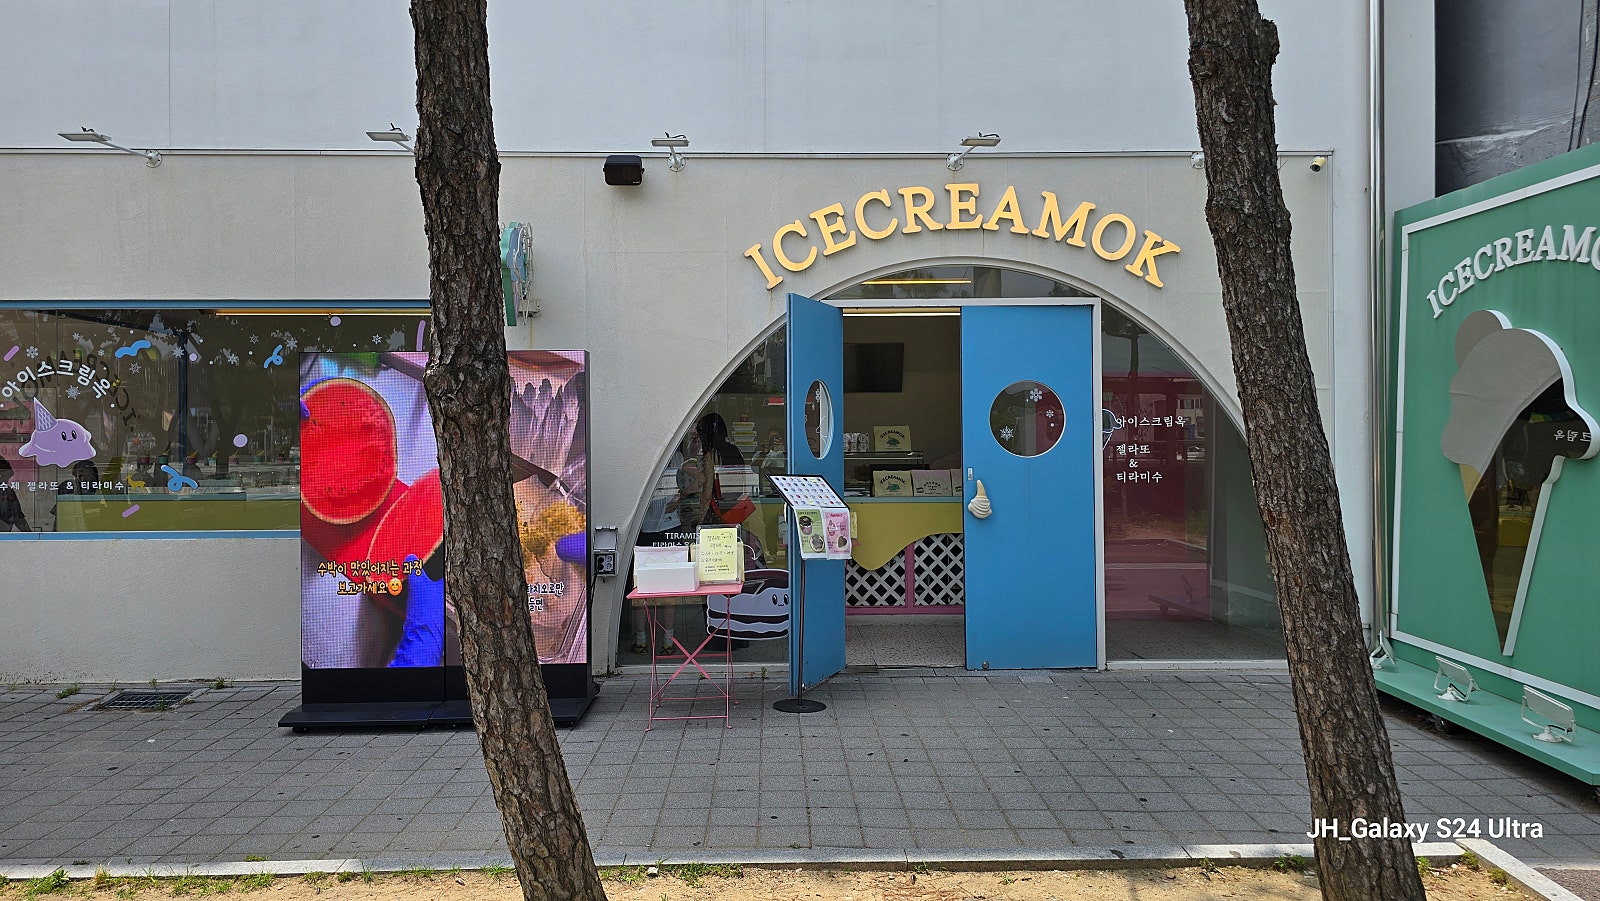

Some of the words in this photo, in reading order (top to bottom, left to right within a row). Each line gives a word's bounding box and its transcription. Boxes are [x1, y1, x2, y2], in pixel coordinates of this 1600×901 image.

[744, 183, 1181, 291] ICECREAMOK
[1, 359, 111, 399] 아이스크림옥
[1116, 415, 1187, 428] 아이스크림옥
[1116, 443, 1151, 455] 젤라또
[1128, 458, 1139, 468] &
[1116, 471, 1163, 484] 티라미수
[0, 481, 20, 491] 수제
[27, 481, 60, 492] 젤라또
[66, 482, 74, 490] &
[80, 481, 125, 491] 티라미수
[317, 560, 348, 577] 수박이
[350, 559, 400, 577] 맛있어지는
[402, 559, 424, 577] 과정
[337, 581, 389, 596] 보고가세요
